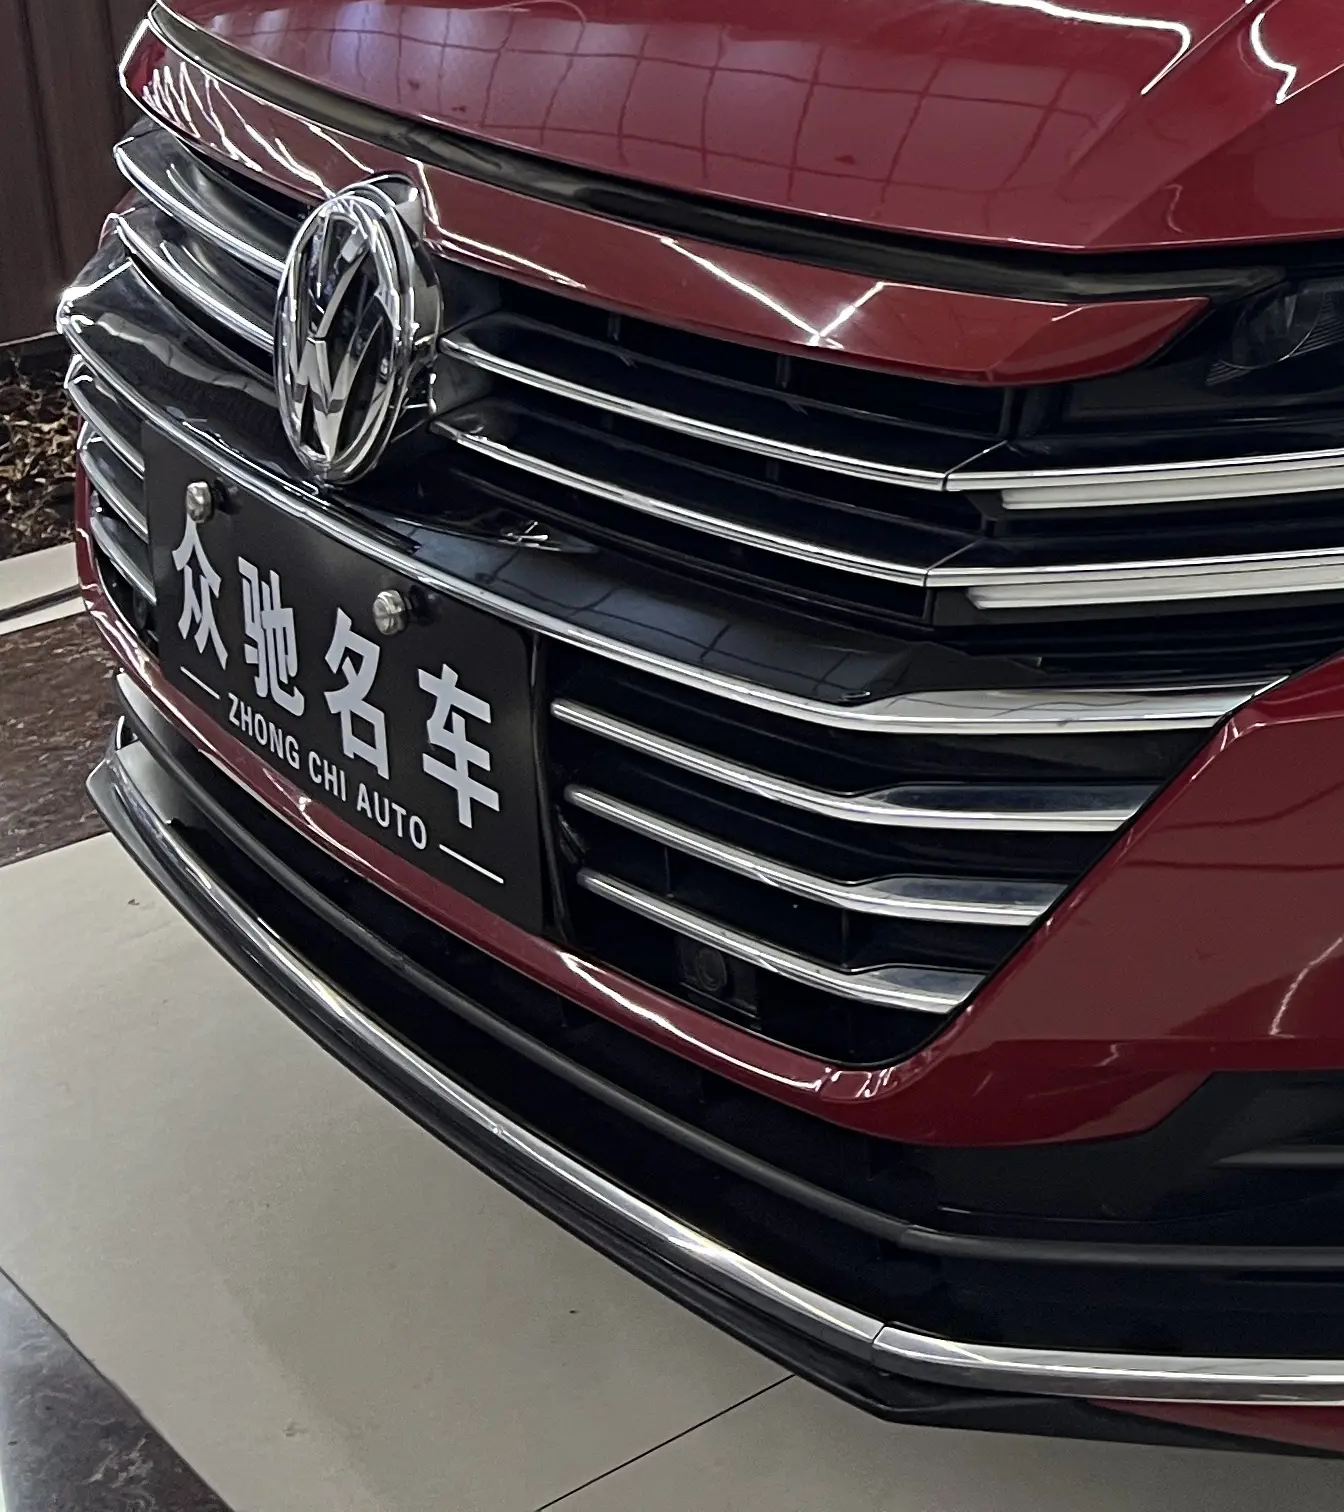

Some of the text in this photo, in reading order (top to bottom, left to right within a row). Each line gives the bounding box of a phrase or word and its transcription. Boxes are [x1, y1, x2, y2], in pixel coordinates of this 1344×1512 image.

[171, 518, 500, 830] 众驰名车
[228, 692, 428, 852] ZHONG CHI AUTO
